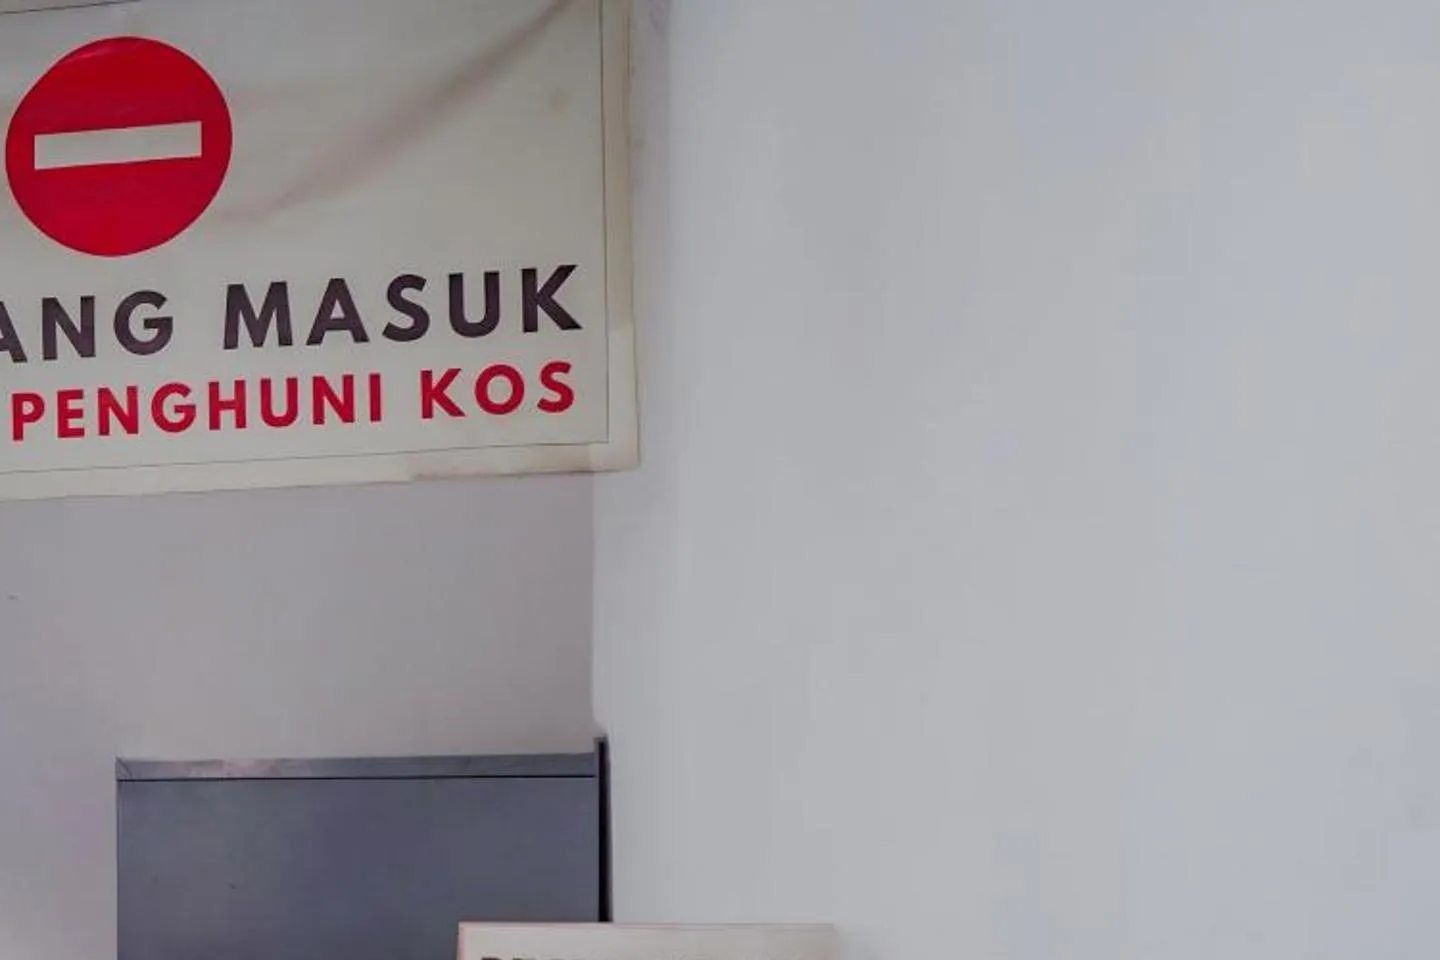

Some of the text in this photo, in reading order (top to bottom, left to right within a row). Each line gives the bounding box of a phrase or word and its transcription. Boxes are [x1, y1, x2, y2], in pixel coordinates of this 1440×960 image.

[222, 264, 584, 350] MASUK
[11, 371, 383, 443] PENGHUNI
[419, 361, 576, 419] KOS
